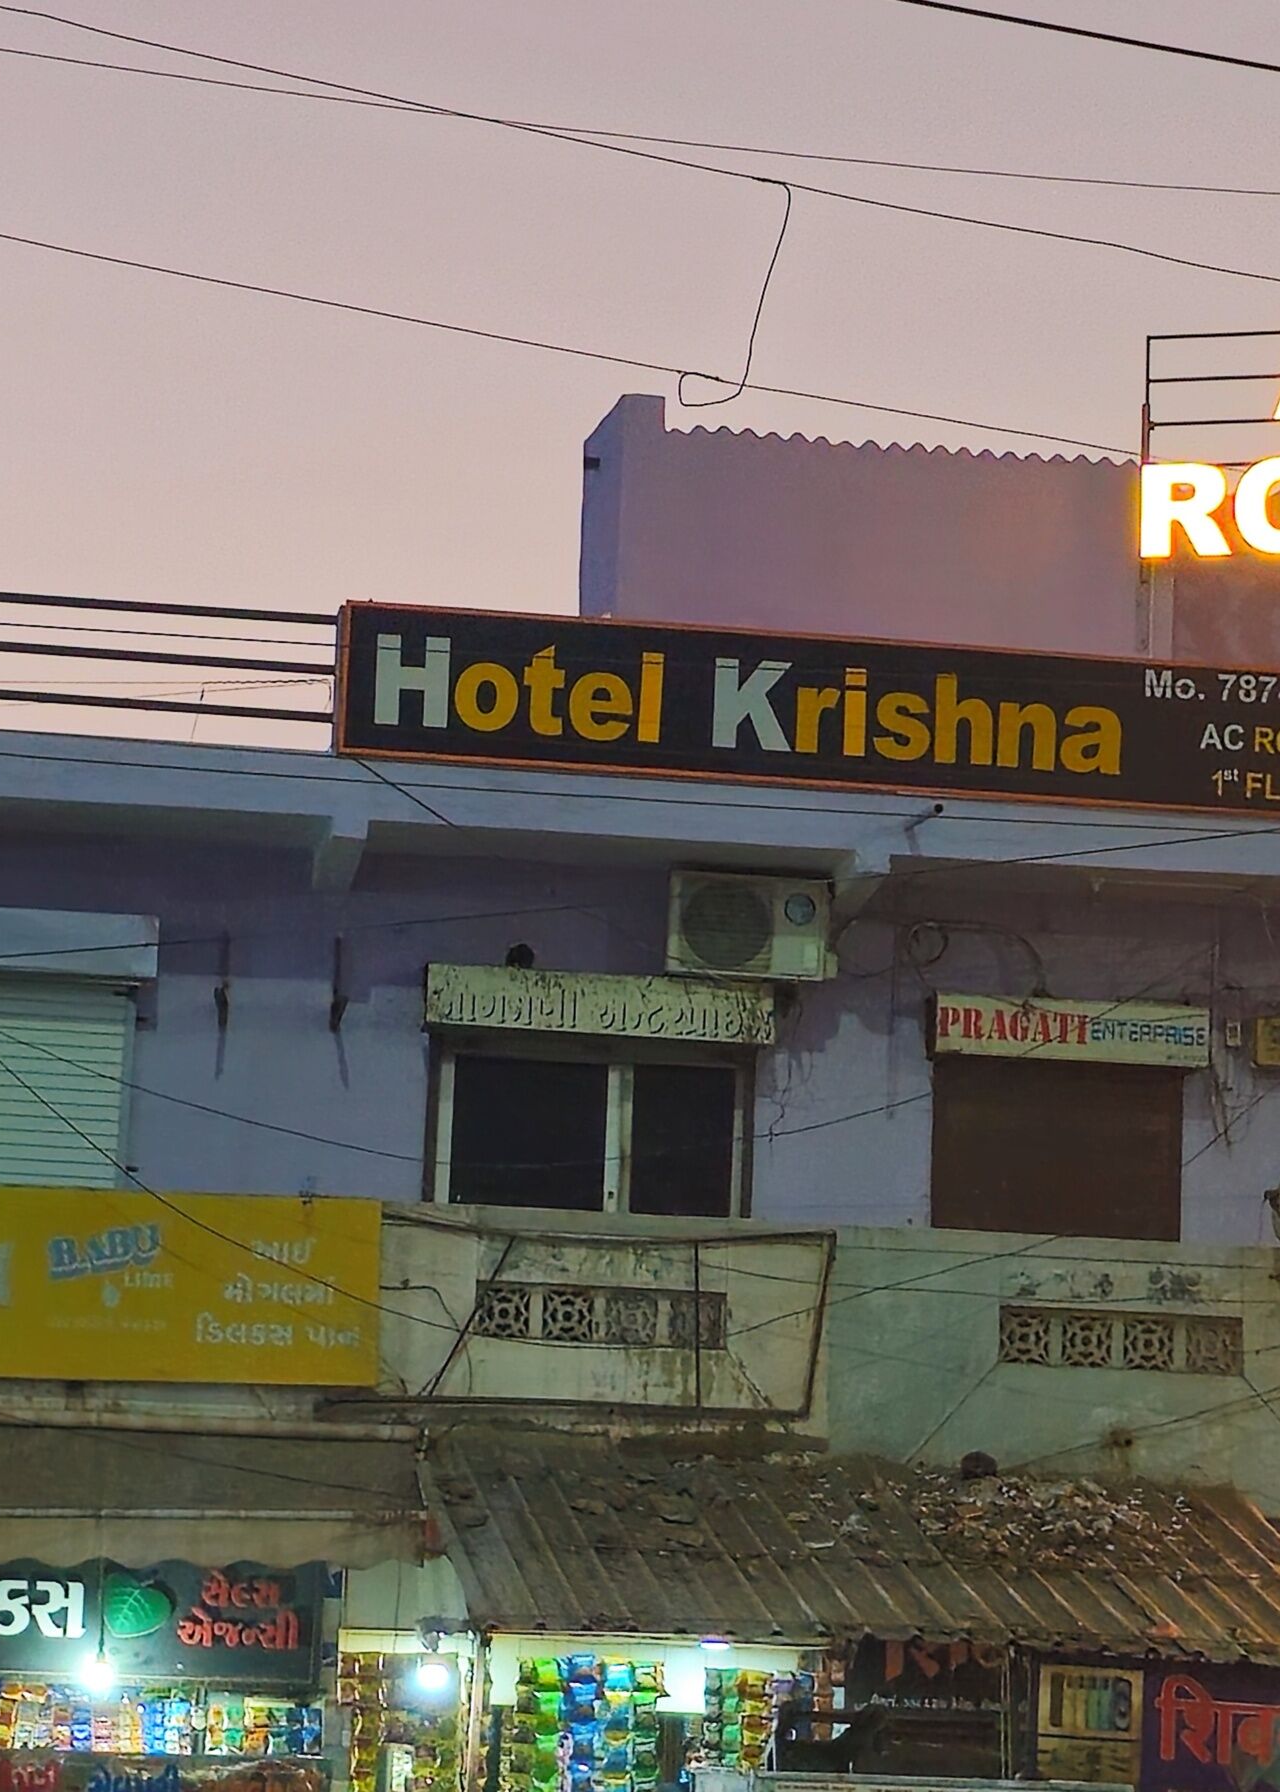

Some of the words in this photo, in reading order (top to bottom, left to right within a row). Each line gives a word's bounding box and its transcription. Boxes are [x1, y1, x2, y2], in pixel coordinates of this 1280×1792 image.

[373, 634, 661, 742] Hotel
[711, 657, 1121, 774] Krishna
[1145, 668, 1204, 702] Mo.
[1201, 722, 1244, 752] AC
[937, 1005, 1089, 1046] PRAGATI
[1091, 1019, 1207, 1047] ENTERPRISE
[47, 1222, 161, 1281] BABU
